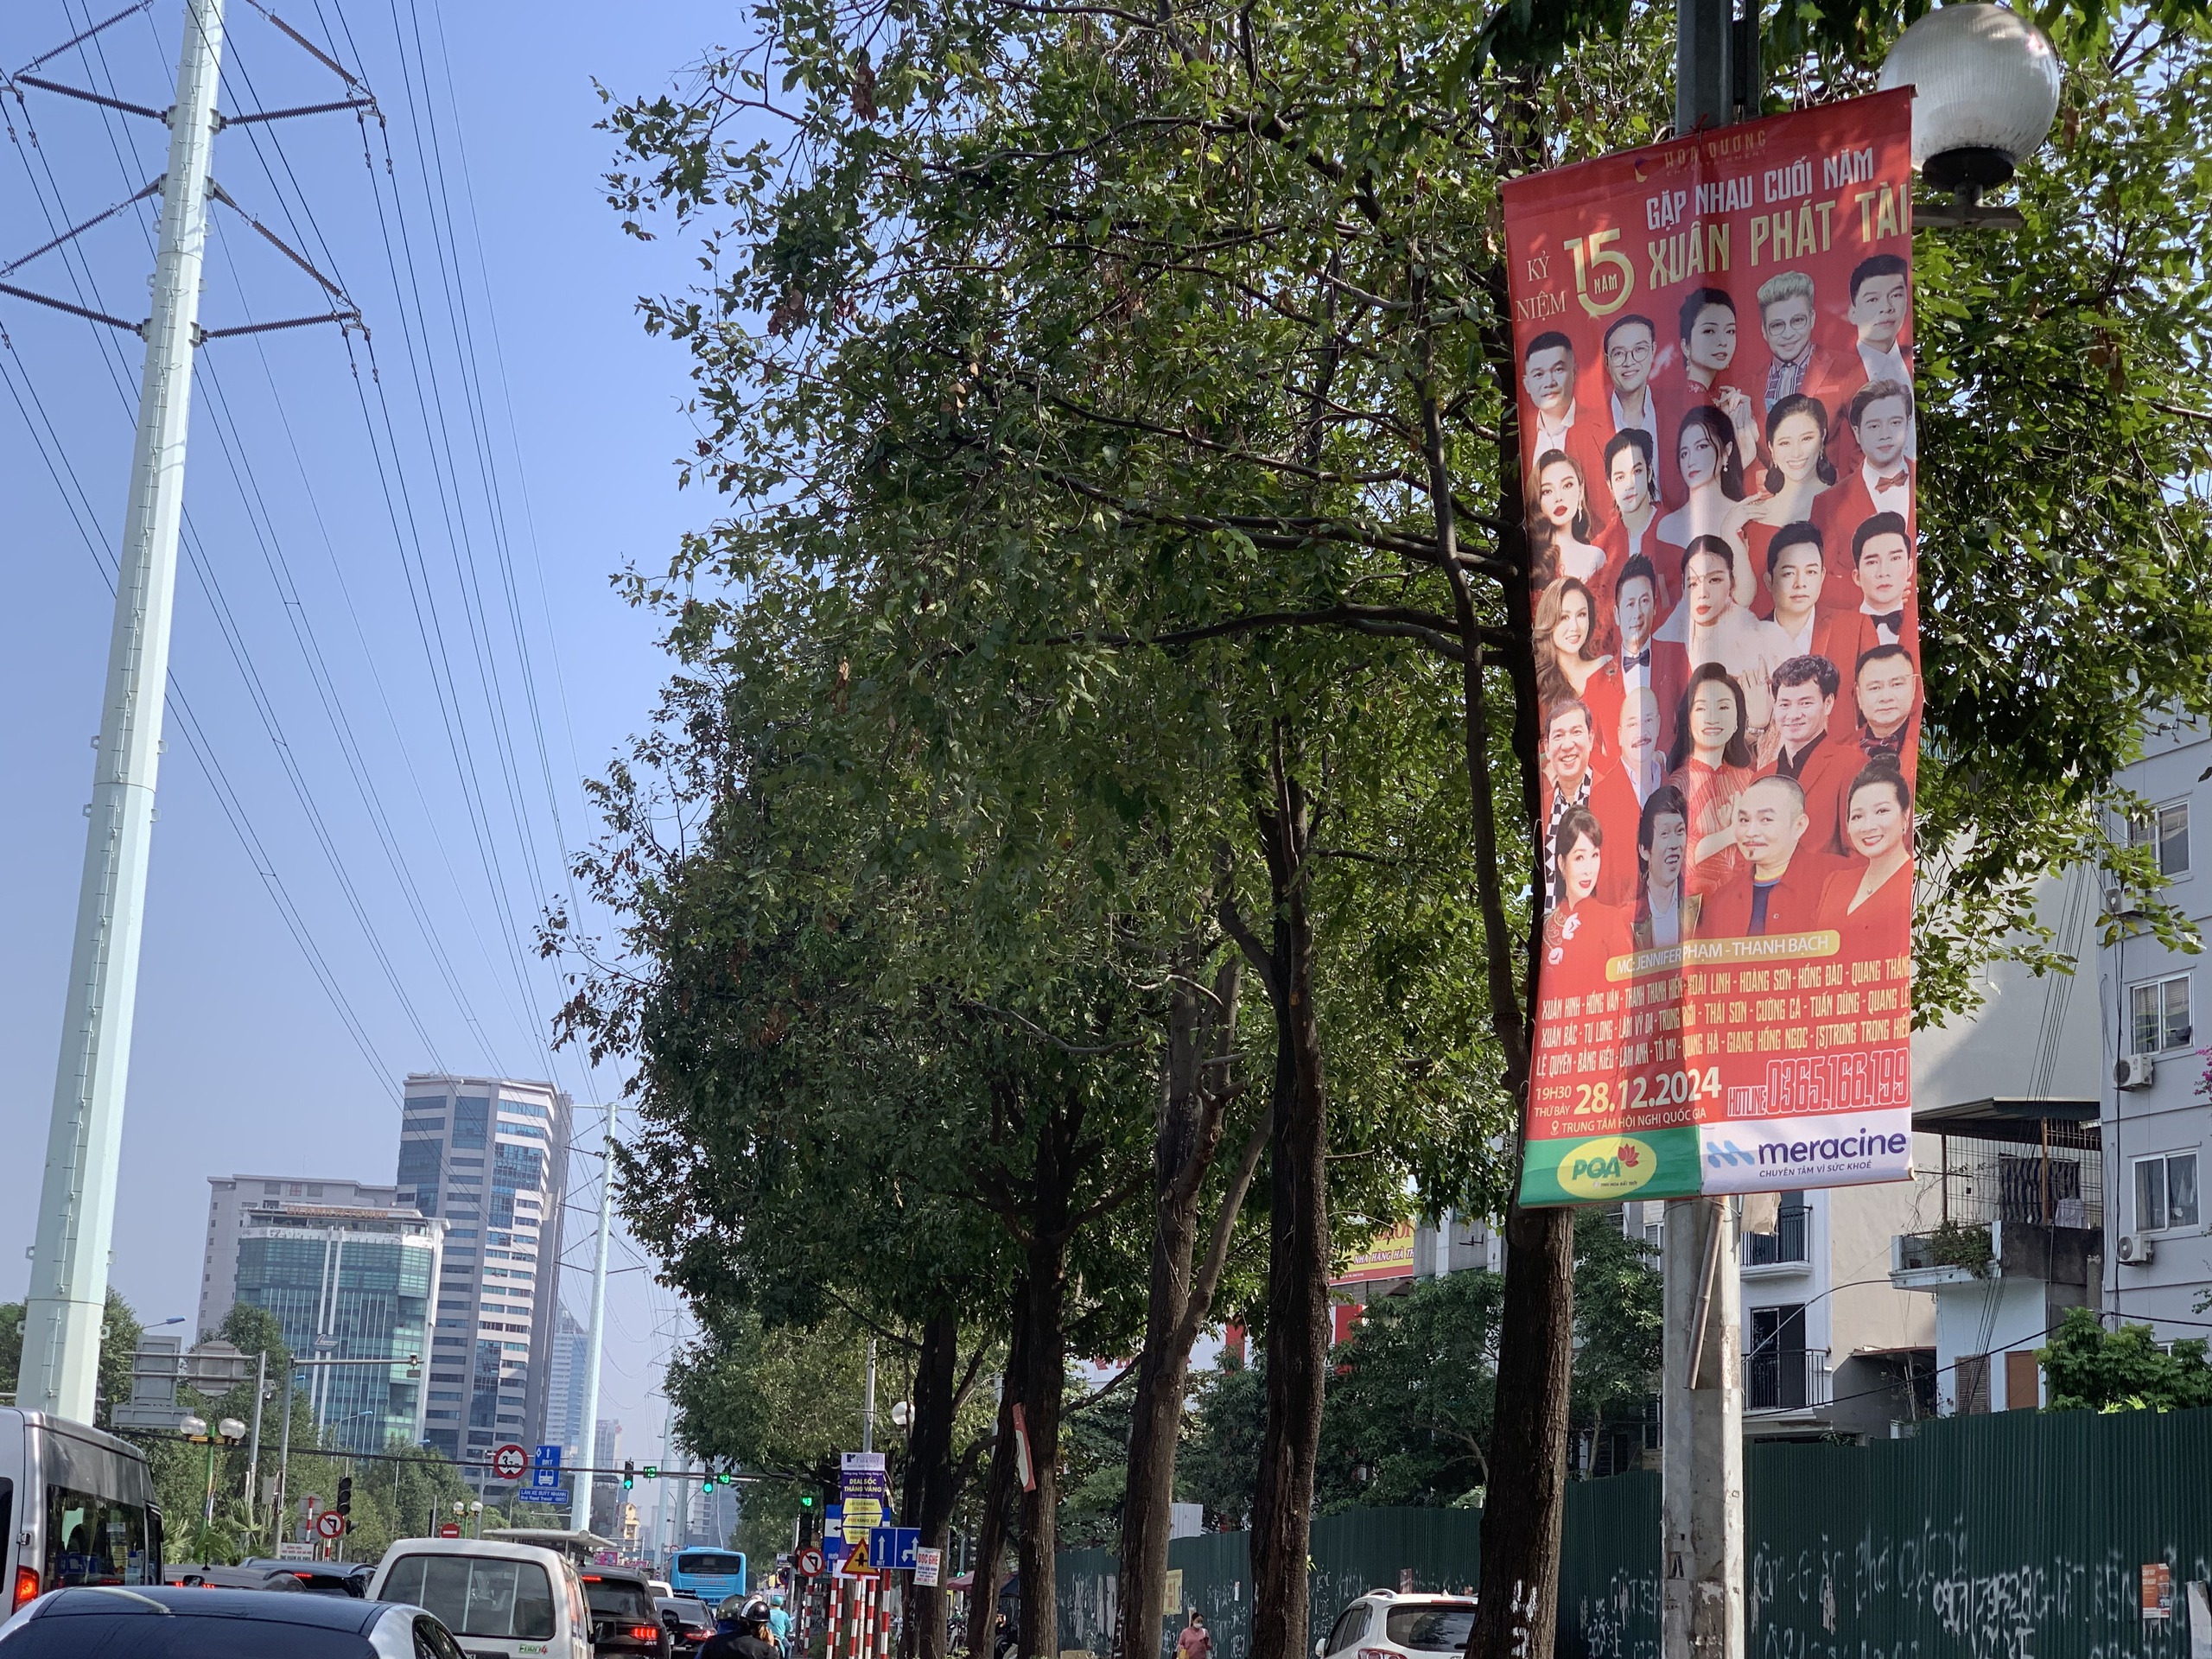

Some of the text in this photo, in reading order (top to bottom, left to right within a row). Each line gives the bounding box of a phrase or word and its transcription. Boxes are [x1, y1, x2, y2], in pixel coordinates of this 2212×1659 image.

[1664, 145, 1698, 168] HOA
[1646, 147, 1873, 232] GẶP NHAU CUỐI NĂM
[1647, 181, 1908, 290] XUÂN PHÁT TÀI
[1527, 251, 1551, 283] KỶ
[1564, 227, 1635, 317] 15
[1593, 273, 1618, 295] NĂM
[1516, 290, 1567, 323] NIỆM
[1617, 935, 1828, 975] MC: JENNIFER PHẠM THANH BẠCH
[1541, 996, 1563, 1020] XUÂN
[1564, 996, 1581, 1018] HINH
[1711, 972, 1731, 995] LINH
[1739, 968, 1770, 993] HOÀNG
[1773, 968, 1791, 990] SƠN
[1798, 962, 1821, 989] HỒNG
[1825, 962, 1843, 987] ĐÀO
[1852, 959, 1881, 987] QUANG
[1596, 1020, 1613, 1042] LONG
[1659, 1007, 1681, 1031] TRUNG
[1704, 999, 1726, 1025] THÁI
[1729, 999, 1747, 1023] SƠN
[1789, 995, 1801, 1020] CÁ
[1809, 991, 1833, 1018] TUẤN
[1836, 991, 1859, 1016] DŨNG
[1868, 988, 1897, 1014] QUANG
[1635, 1042, 1649, 1065] ANH
[1666, 1039, 1676, 1059] MY
[1682, 1031, 1703, 1060] QUANG
[1707, 1029, 1719, 1054] HÀ
[1726, 1030, 1753, 1053] GIANG
[1757, 1025, 1781, 1052] HỒNG
[1784, 1027, 1808, 1052] NGỌC
[1860, 1019, 1890, 1045] TRỌNG
[1535, 1084, 1572, 1101] 19H30
[1573, 1066, 1722, 1116] 28.12.2024
[1727, 1047, 1910, 1117] HOTLINE 0365.166.199
[1534, 1104, 1554, 1117] THỨ
[1561, 1108, 1707, 1134] TRUNG TÂM HỘI NGHỊ QUỐC GIA
[1758, 1127, 1907, 1166] meracine
[1572, 1155, 1621, 1181] PQA
[1759, 1167, 1796, 1178] CHUYÊN
[1797, 1165, 1815, 1175] TÂM
[1816, 1163, 1827, 1173] VÌ
[1827, 1162, 1846, 1173] SỨC
[1371, 1249, 1392, 1263] HÀNG
[1393, 1245, 1404, 1261] HÀ
[719, 1474, 730, 1484] 43
[863, 1476, 877, 1484] SỐC
[802, 1497, 812, 1507] 43
